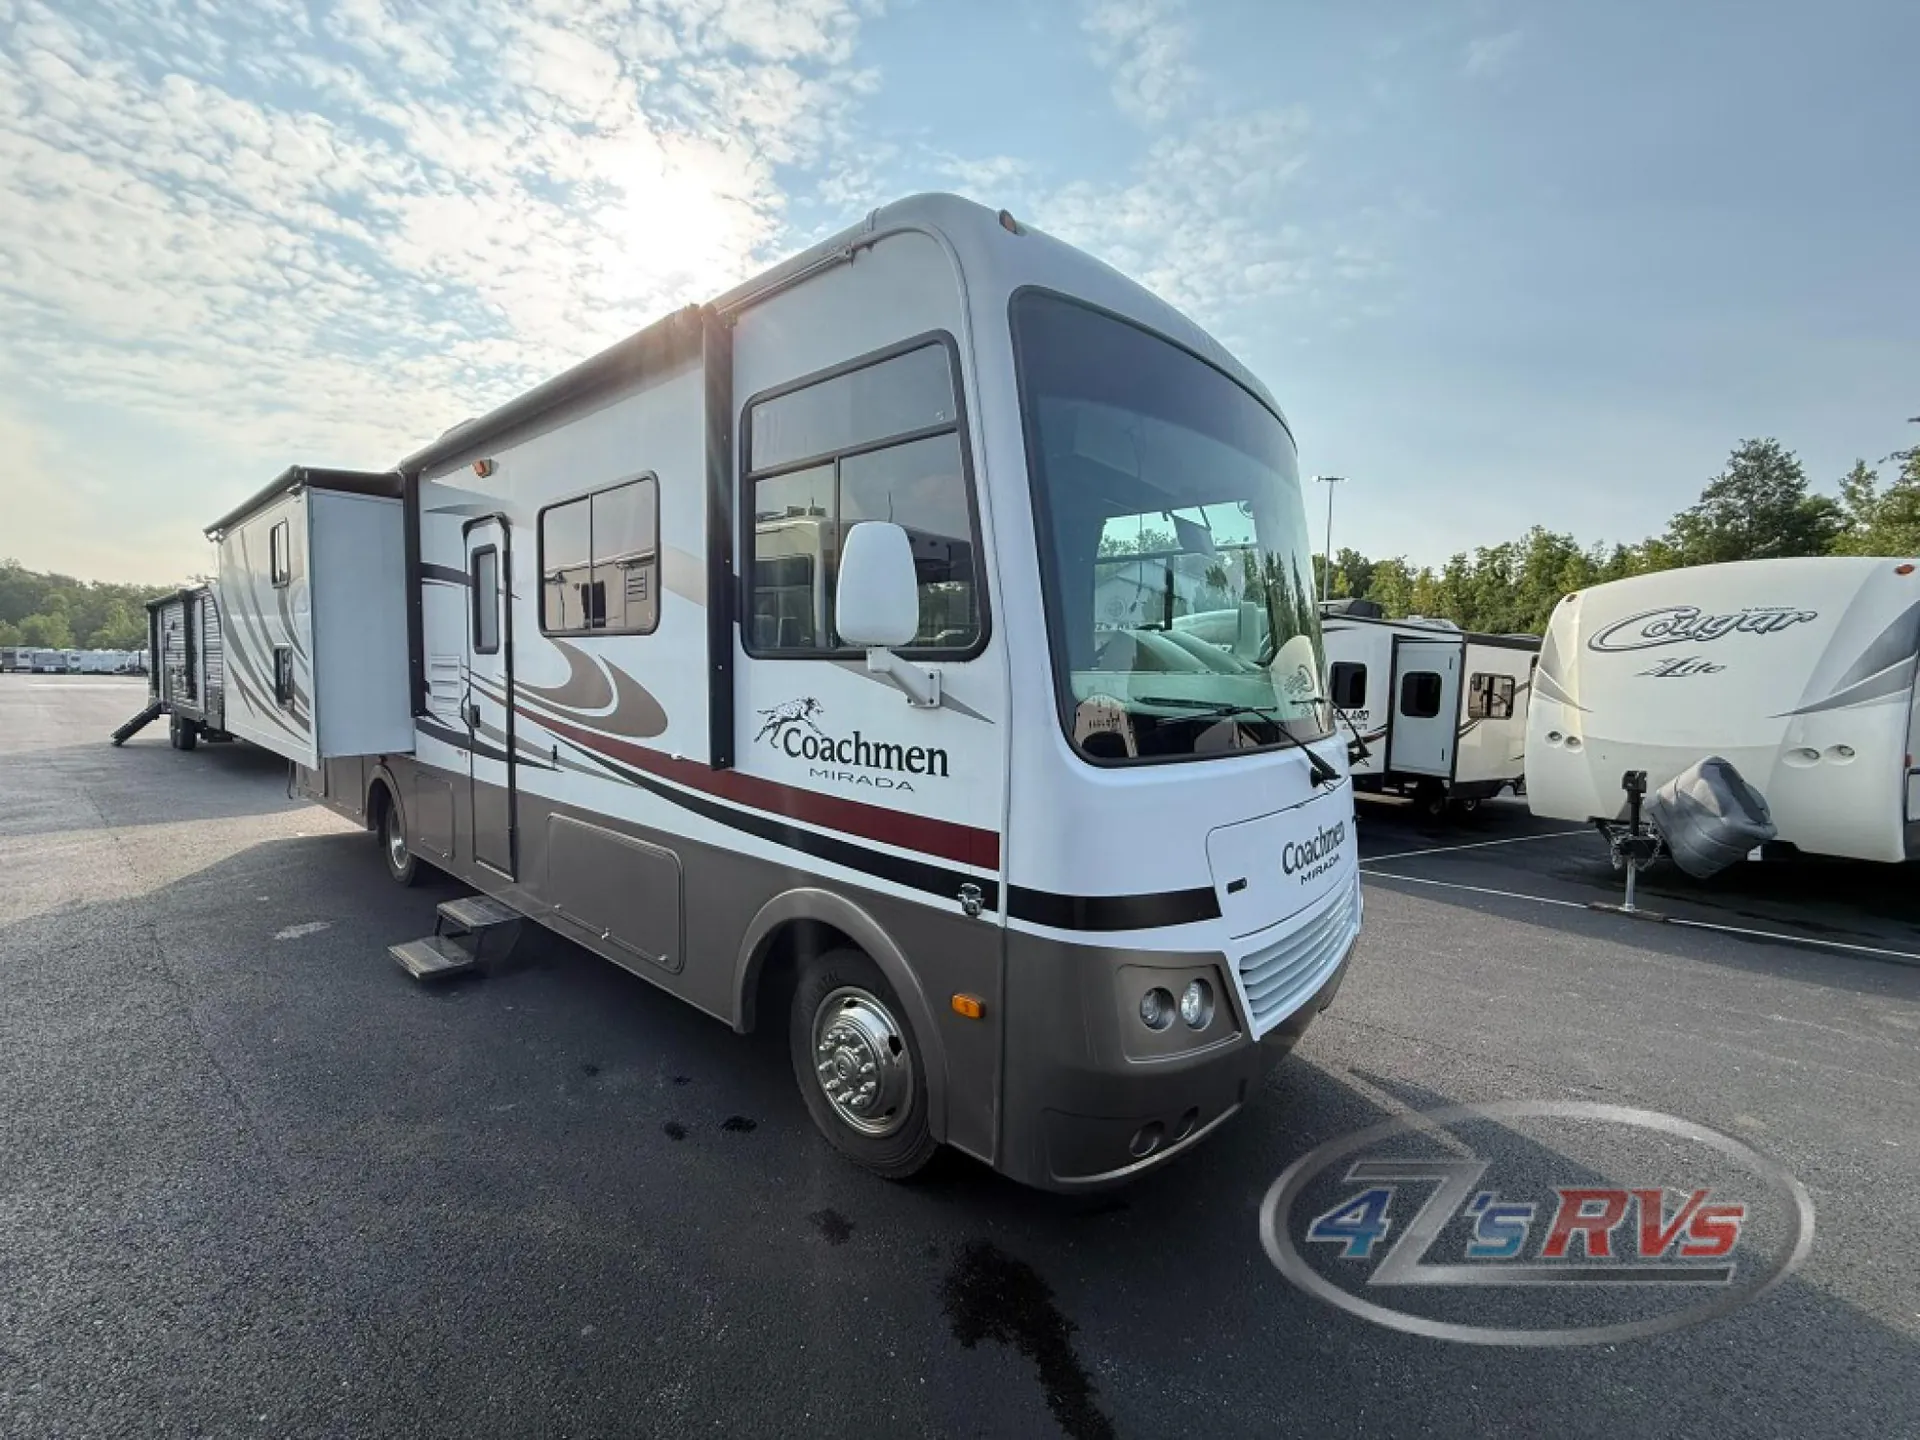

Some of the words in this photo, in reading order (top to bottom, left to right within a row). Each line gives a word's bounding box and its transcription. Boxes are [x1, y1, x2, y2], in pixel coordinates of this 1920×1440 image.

[1588, 605, 1818, 652] Cougar
[783, 727, 949, 777] Coachmen
[809, 767, 914, 792] MIRADA
[1282, 820, 1345, 875] Coachmen
[1300, 853, 1340, 886] MIRADA
